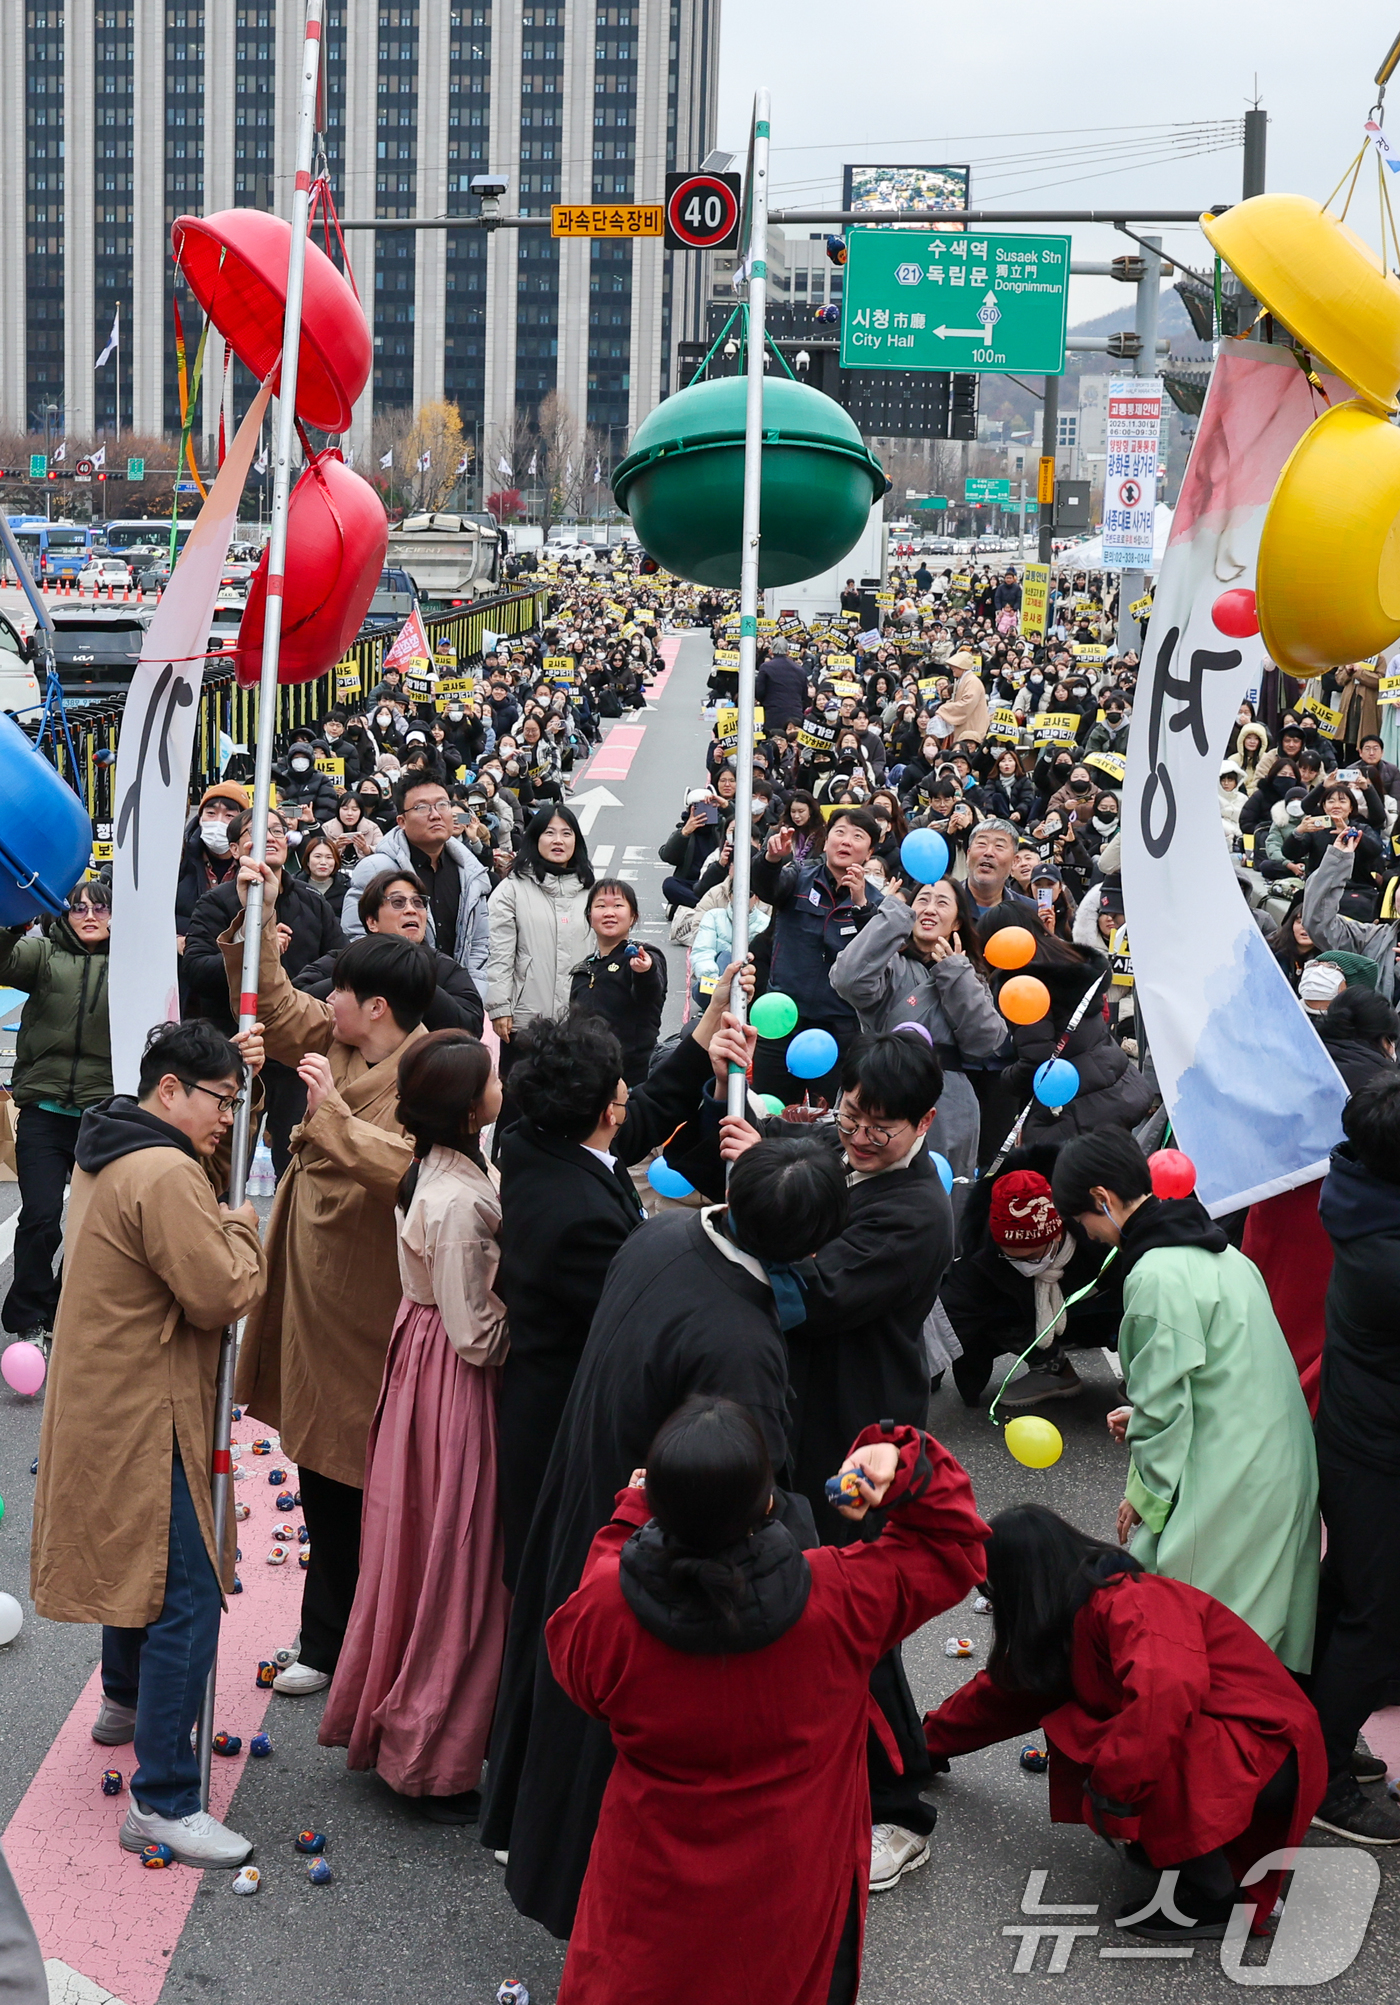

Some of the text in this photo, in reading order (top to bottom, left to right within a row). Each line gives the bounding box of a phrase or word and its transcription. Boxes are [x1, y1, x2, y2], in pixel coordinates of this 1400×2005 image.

[684, 195, 722, 228] 40
[556, 210, 659, 234] 과속단속장비
[927, 241, 989, 261] 수색역
[995, 247, 1062, 264] Susaek Stn
[903, 267, 919, 283] 21
[926, 265, 989, 287] 독립문
[995, 264, 1038, 280] 獨立門
[994, 279, 1062, 294] Dongnimmun
[852, 308, 890, 329] 시청
[893, 312, 927, 329] 市廳
[982, 309, 998, 321] 50
[852, 332, 915, 350] City Hall
[971, 348, 1006, 364] 100m
[1108, 454, 1155, 478] 광화문 삼거리
[1104, 509, 1153, 533] 세종대로 사거리
[392, 545, 444, 554] XCIENT
[1025, 570, 1047, 584] 교통안내
[1022, 611, 1042, 624] 공사중
[442, 682, 467, 691] 교사도
[1310, 703, 1334, 721] 교사도
[1042, 717, 1071, 727] 교사도
[1036, 728, 1076, 740] 시민이다!
